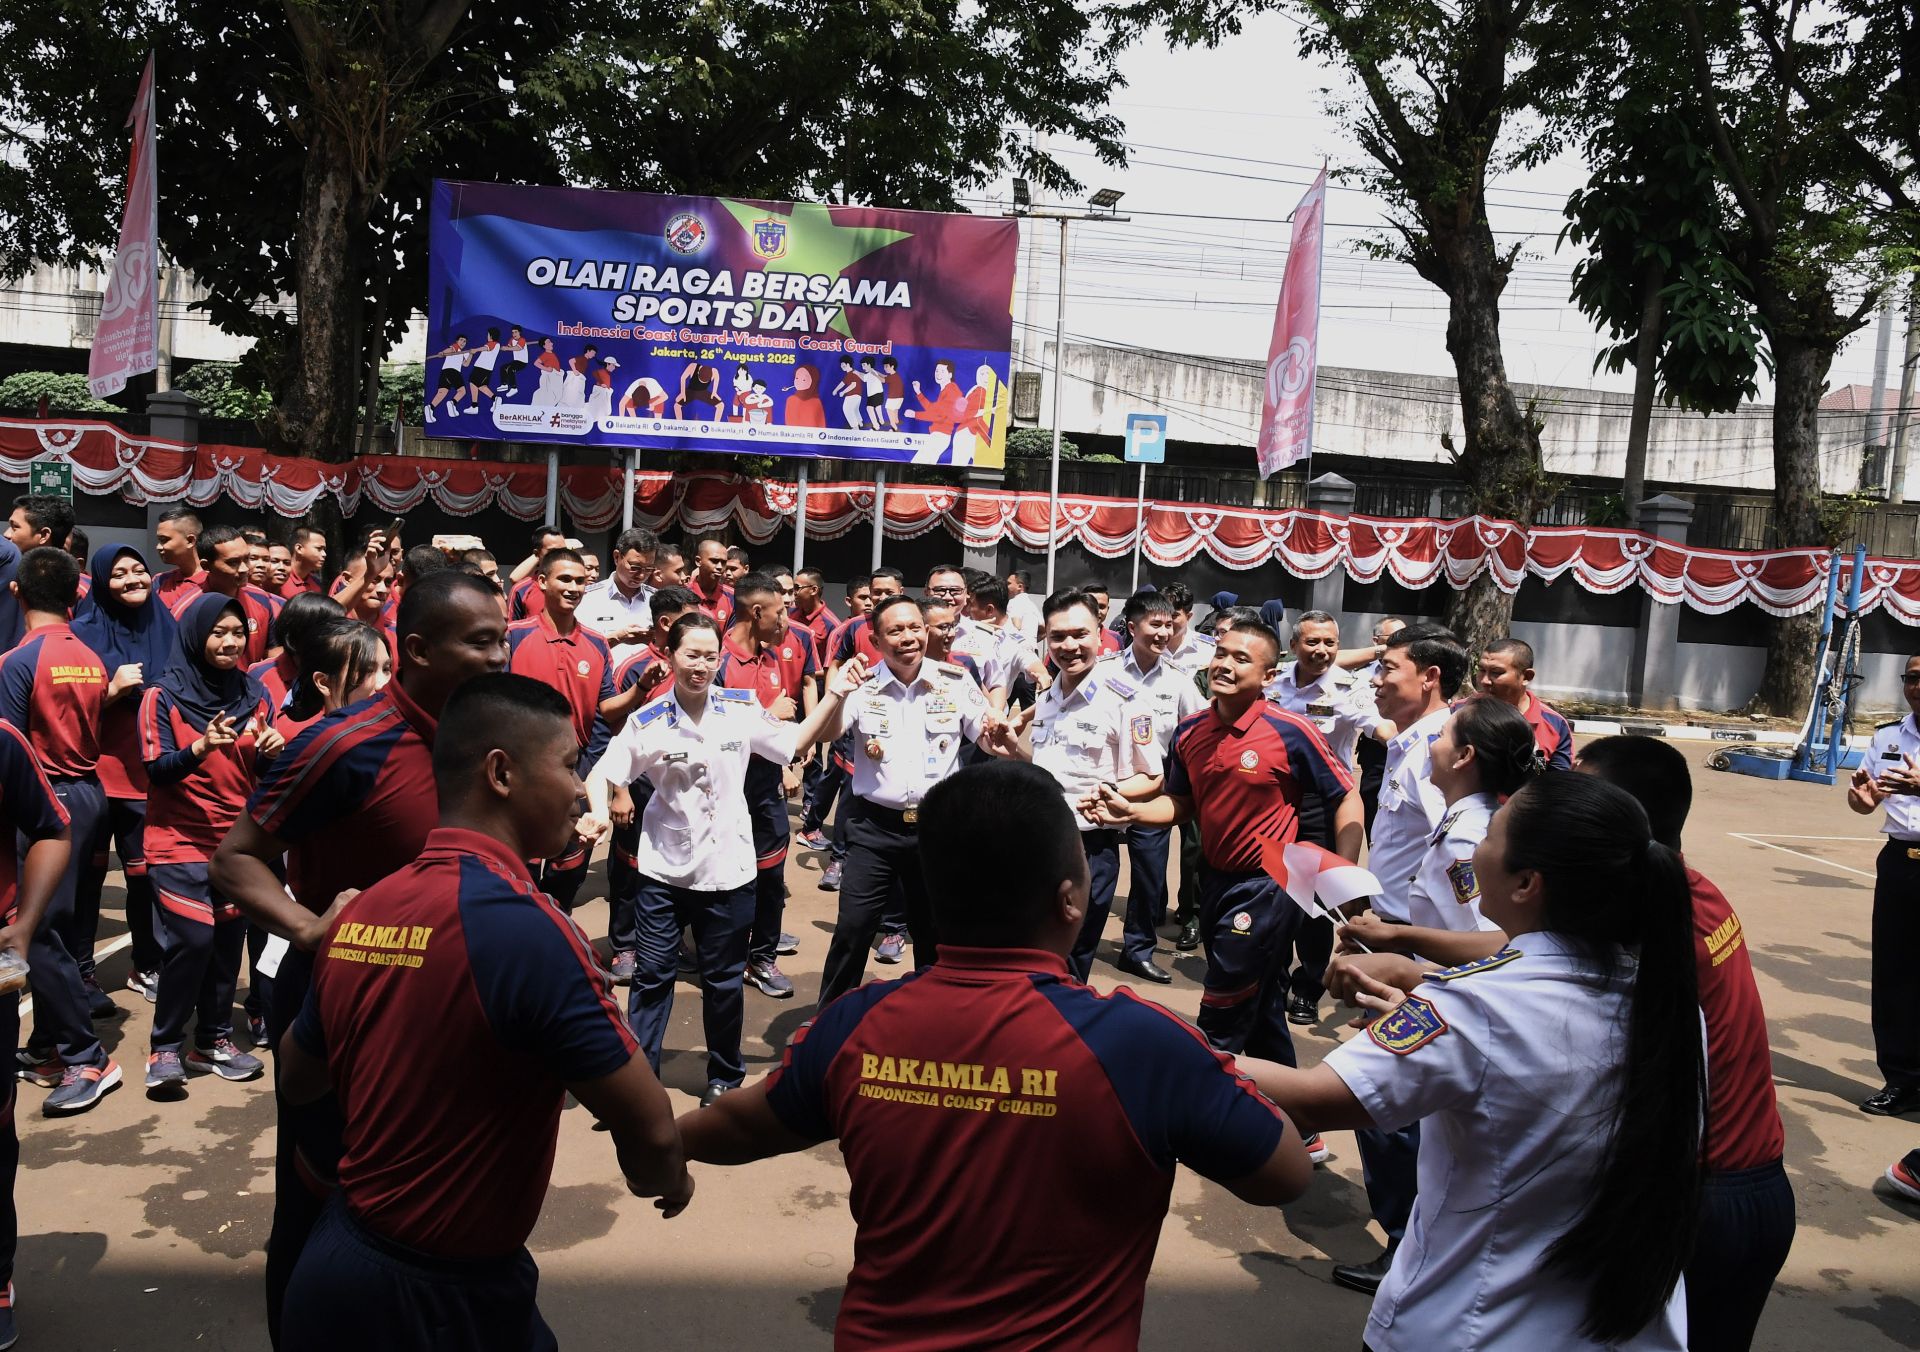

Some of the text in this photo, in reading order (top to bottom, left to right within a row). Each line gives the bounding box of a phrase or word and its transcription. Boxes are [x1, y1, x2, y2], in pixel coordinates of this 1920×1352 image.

[526, 258, 912, 308] OLAH RAGA BERSAMA
[612, 293, 839, 333] SPORTS DAY
[557, 320, 631, 339] Indonesia
[633, 325, 677, 342] Coast
[799, 335, 842, 352] Coast
[844, 338, 893, 355] Guard
[650, 346, 698, 360] Jakarta,
[723, 350, 765, 364] August
[767, 353, 796, 364] 2025
[499, 413, 543, 423] BerAKHLAK
[827, 434, 861, 442] Indonesian
[1131, 420, 1160, 457] P
[408, 925, 433, 951] RI
[860, 1053, 1058, 1097] BAKAMLA RI
[858, 1083, 1057, 1117] INDONESIA COAST GUARD
